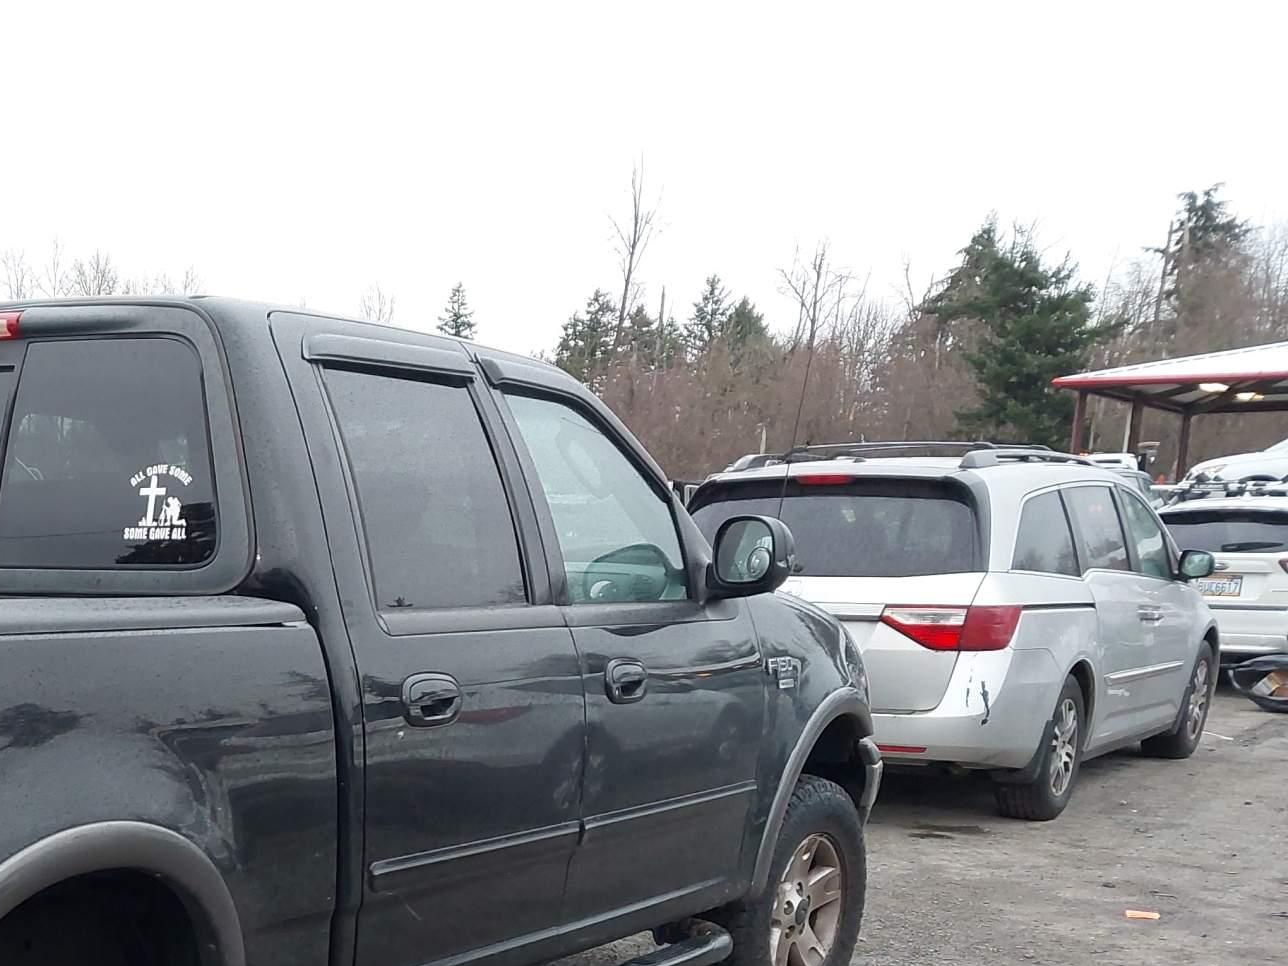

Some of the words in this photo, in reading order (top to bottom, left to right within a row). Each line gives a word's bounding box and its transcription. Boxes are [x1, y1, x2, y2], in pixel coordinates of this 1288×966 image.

[130, 471, 146, 487] ALL
[146, 464, 169, 477] GAVE
[168, 465, 193, 486] SOME
[123, 527, 148, 540] SOME
[149, 527, 170, 540] GAVE
[171, 527, 187, 540] ALL
